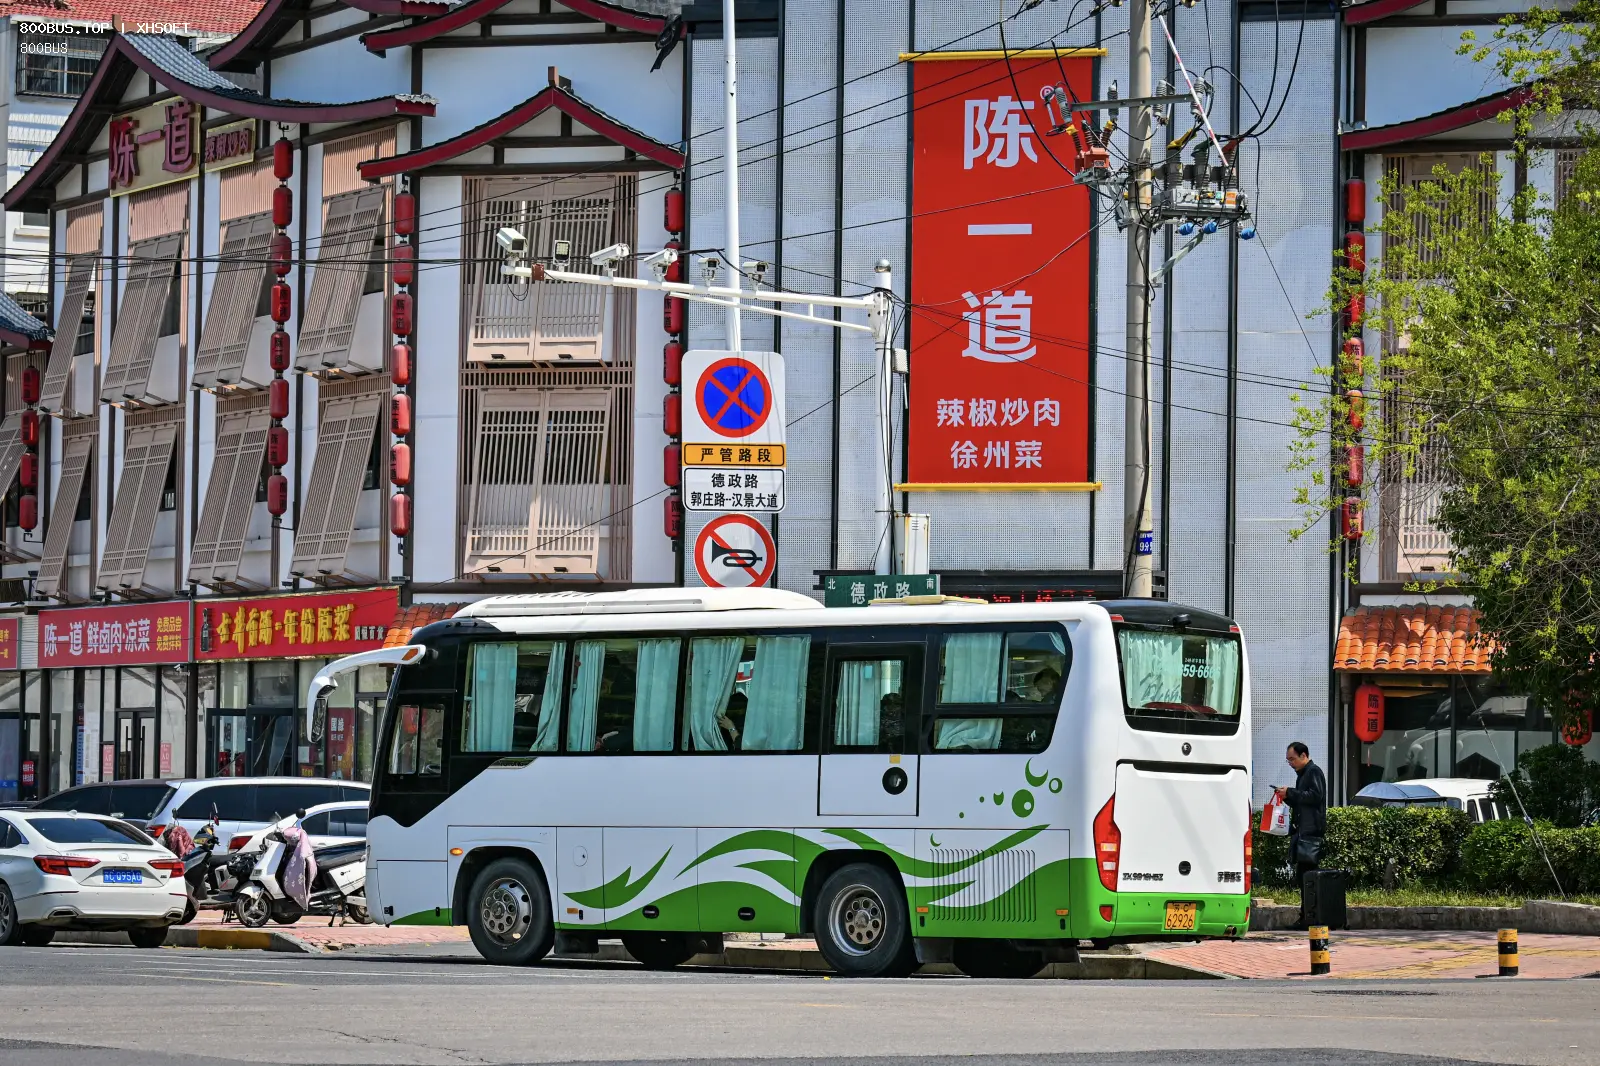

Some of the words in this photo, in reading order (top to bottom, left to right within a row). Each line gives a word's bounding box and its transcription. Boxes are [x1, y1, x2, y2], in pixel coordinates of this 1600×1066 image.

[108, 101, 198, 190] 陈一道
[204, 127, 251, 164] 辣椒炒肉
[962, 95, 1038, 363] 陈一道
[936, 397, 1061, 428] 辣椒炒肉
[700, 447, 771, 463] 严管路段
[950, 439, 1043, 469] 徐州菜
[711, 472, 759, 489] 德政路
[828, 578, 836, 590] 北
[850, 581, 911, 605] 德政路
[926, 577, 935, 589] 南
[1166, 913, 1194, 928] 62926
